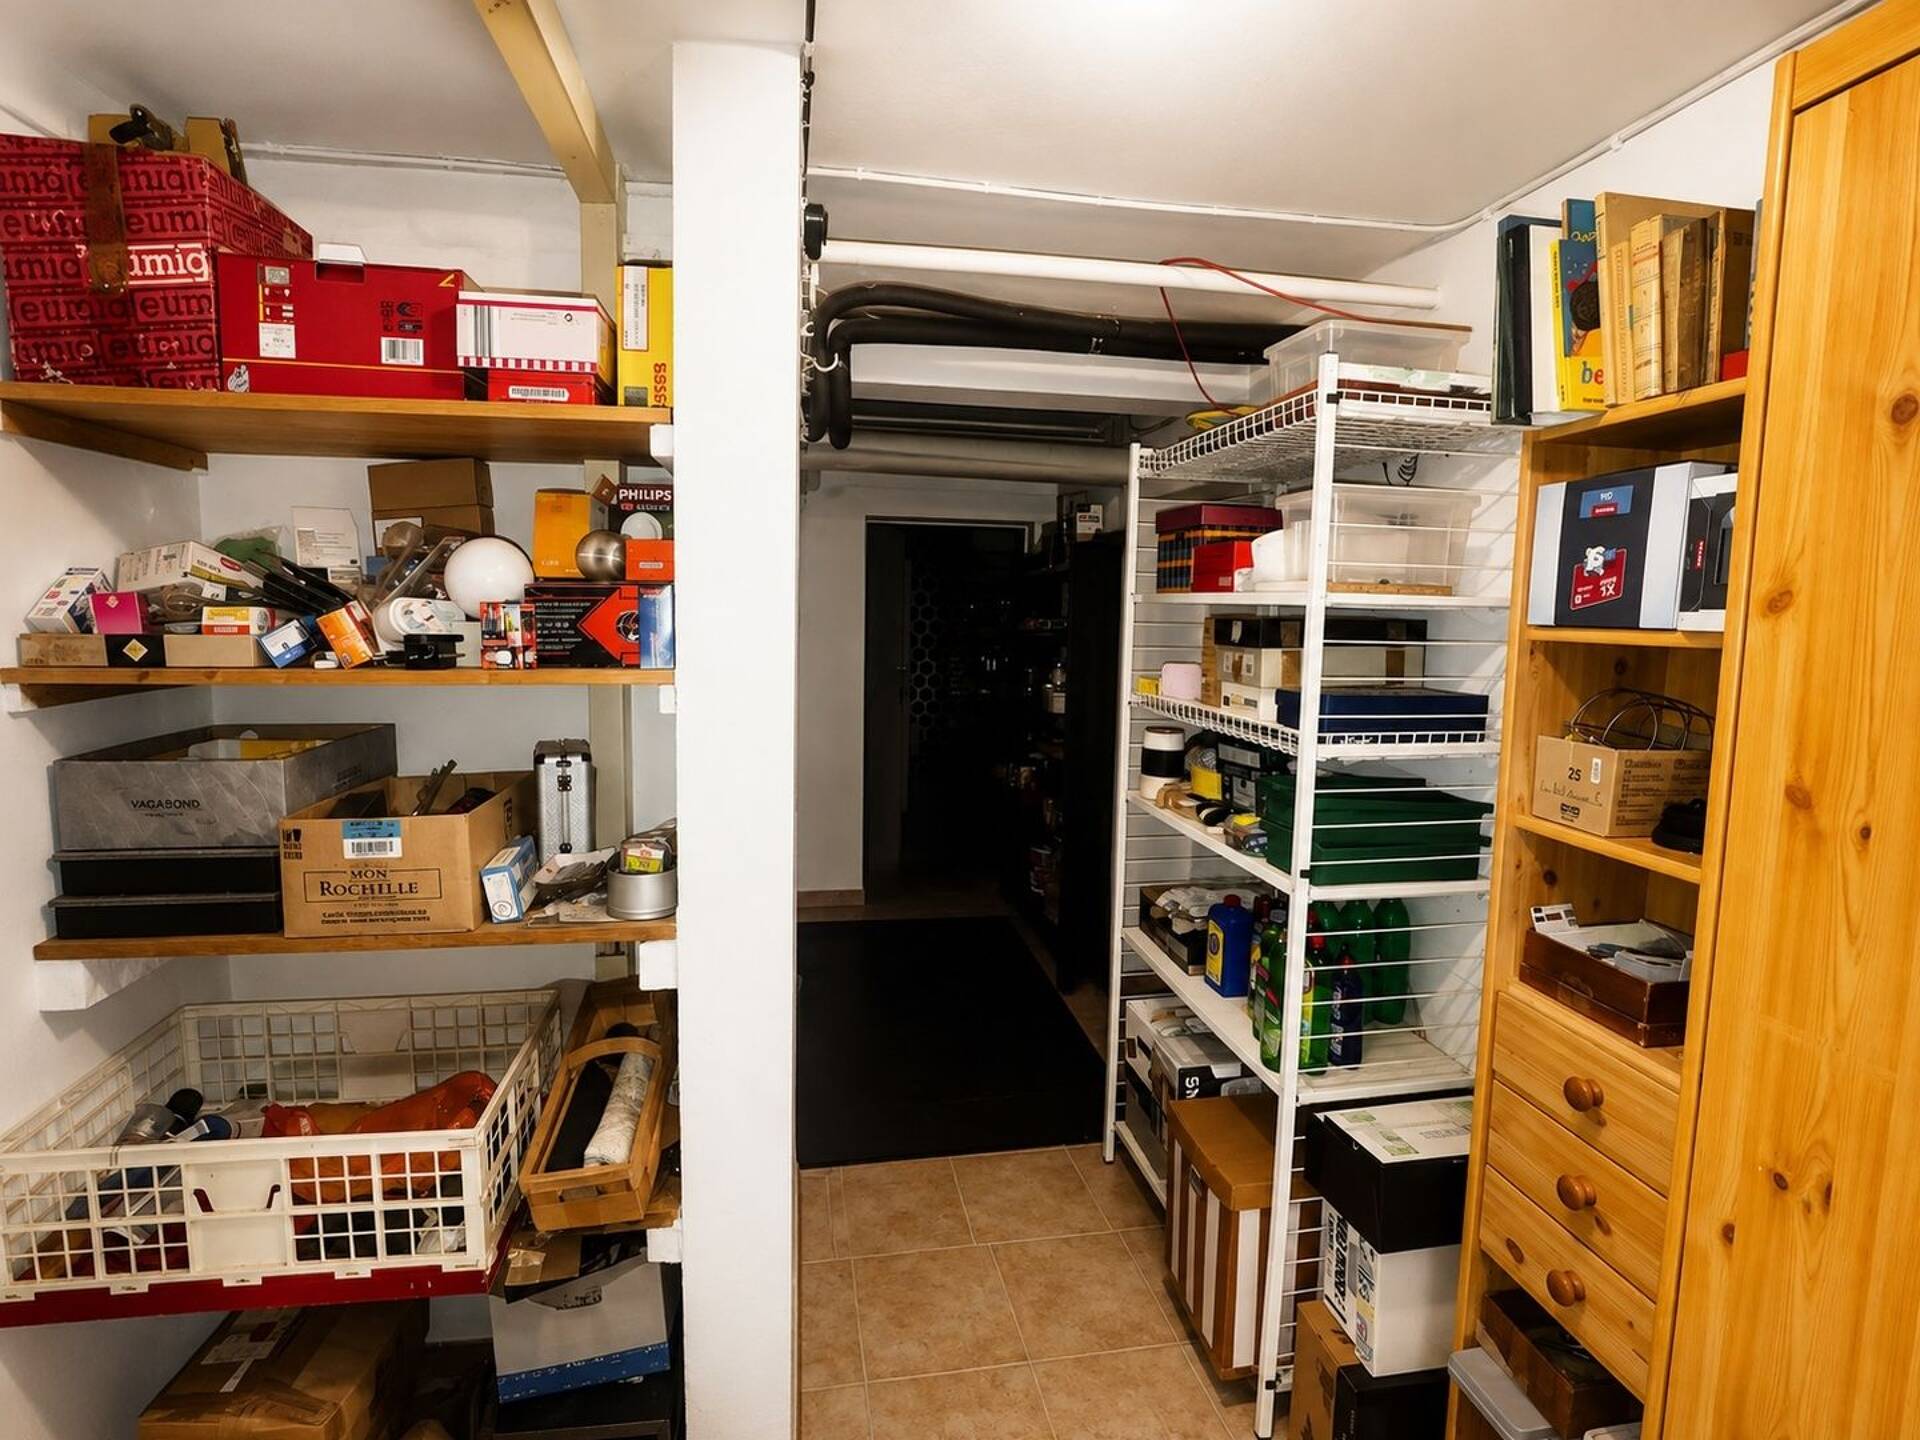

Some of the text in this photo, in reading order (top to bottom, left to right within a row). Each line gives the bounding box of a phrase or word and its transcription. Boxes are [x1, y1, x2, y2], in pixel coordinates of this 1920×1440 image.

[619, 488, 672, 501] PHILIPS
[1567, 766, 1582, 782] 25
[131, 799, 201, 809] VAGABOND
[350, 869, 388, 880] MON
